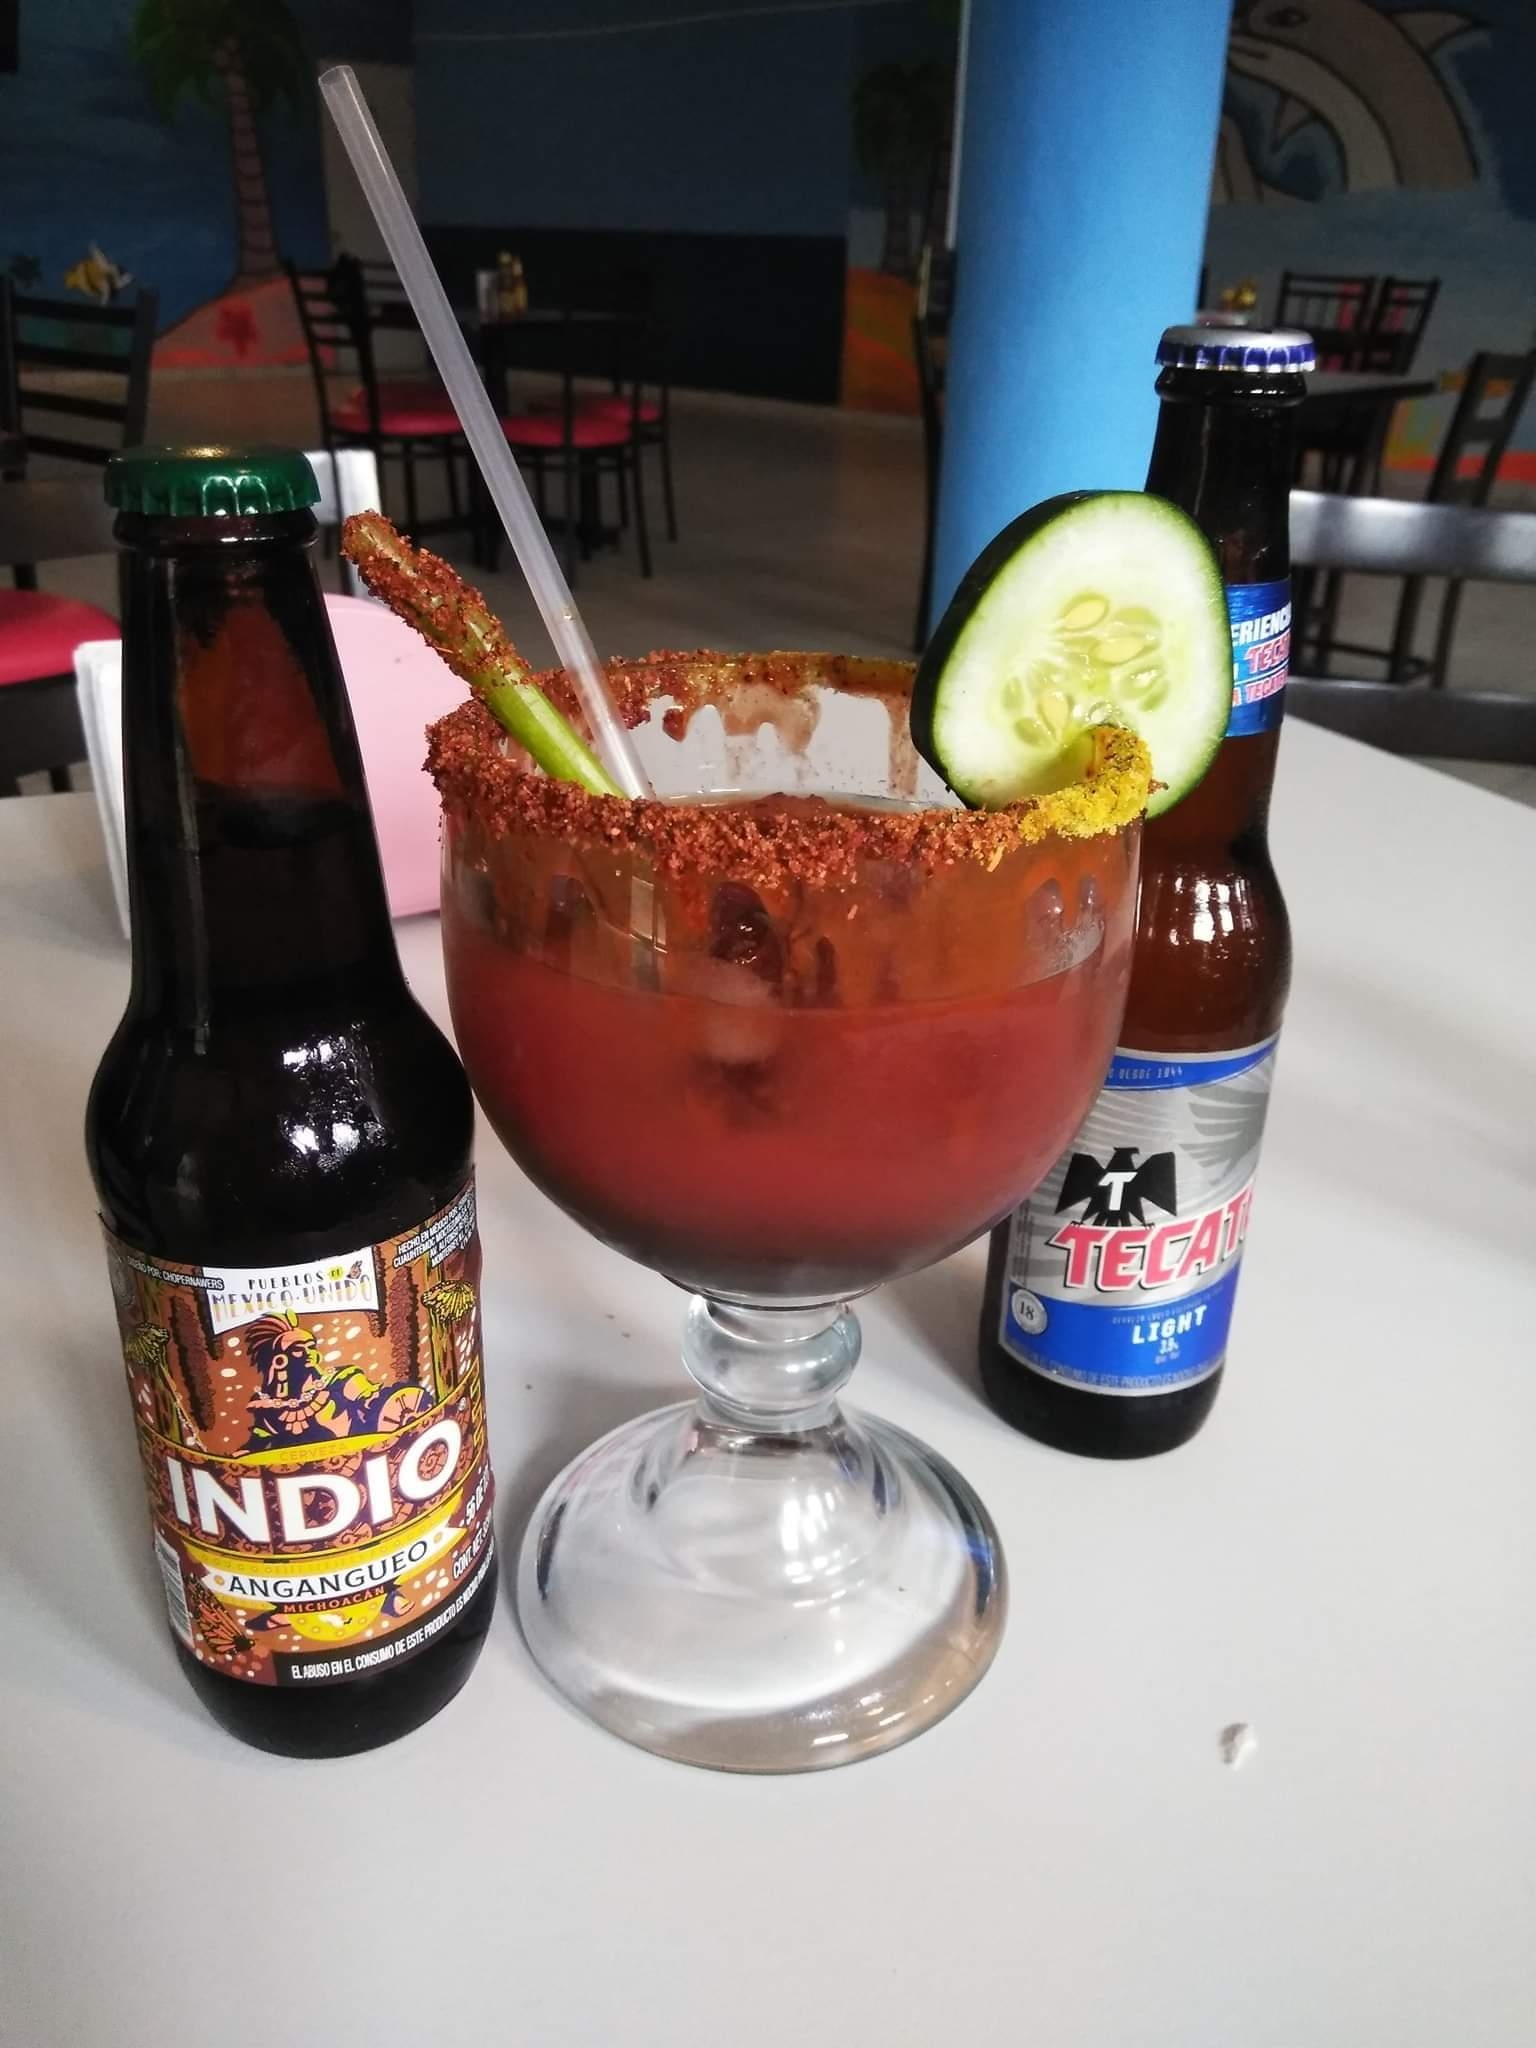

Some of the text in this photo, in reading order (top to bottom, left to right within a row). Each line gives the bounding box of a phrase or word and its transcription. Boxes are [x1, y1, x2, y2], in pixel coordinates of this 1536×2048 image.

[1098, 1172, 1138, 1211] T
[398, 1235, 421, 1254] HECHO
[420, 1229, 429, 1243] EN
[248, 1270, 324, 1290] PUEBLOS
[1020, 1302, 1034, 1321] 18
[1132, 1305, 1207, 1345] LIGHT
[280, 1442, 348, 1461] CERVEZA
[166, 1418, 462, 1543] INDIO
[228, 1539, 429, 1598] ANGANGUEO
[291, 1664, 303, 1679] EL
[303, 1662, 330, 1679] ABUSO
[331, 1660, 343, 1676] EN
[343, 1658, 355, 1673] EL
[355, 1643, 395, 1671] CONSUMO
[395, 1638, 407, 1656] DE
[406, 1626, 425, 1650] ESTE
[424, 1602, 456, 1639] PRODUCTO
